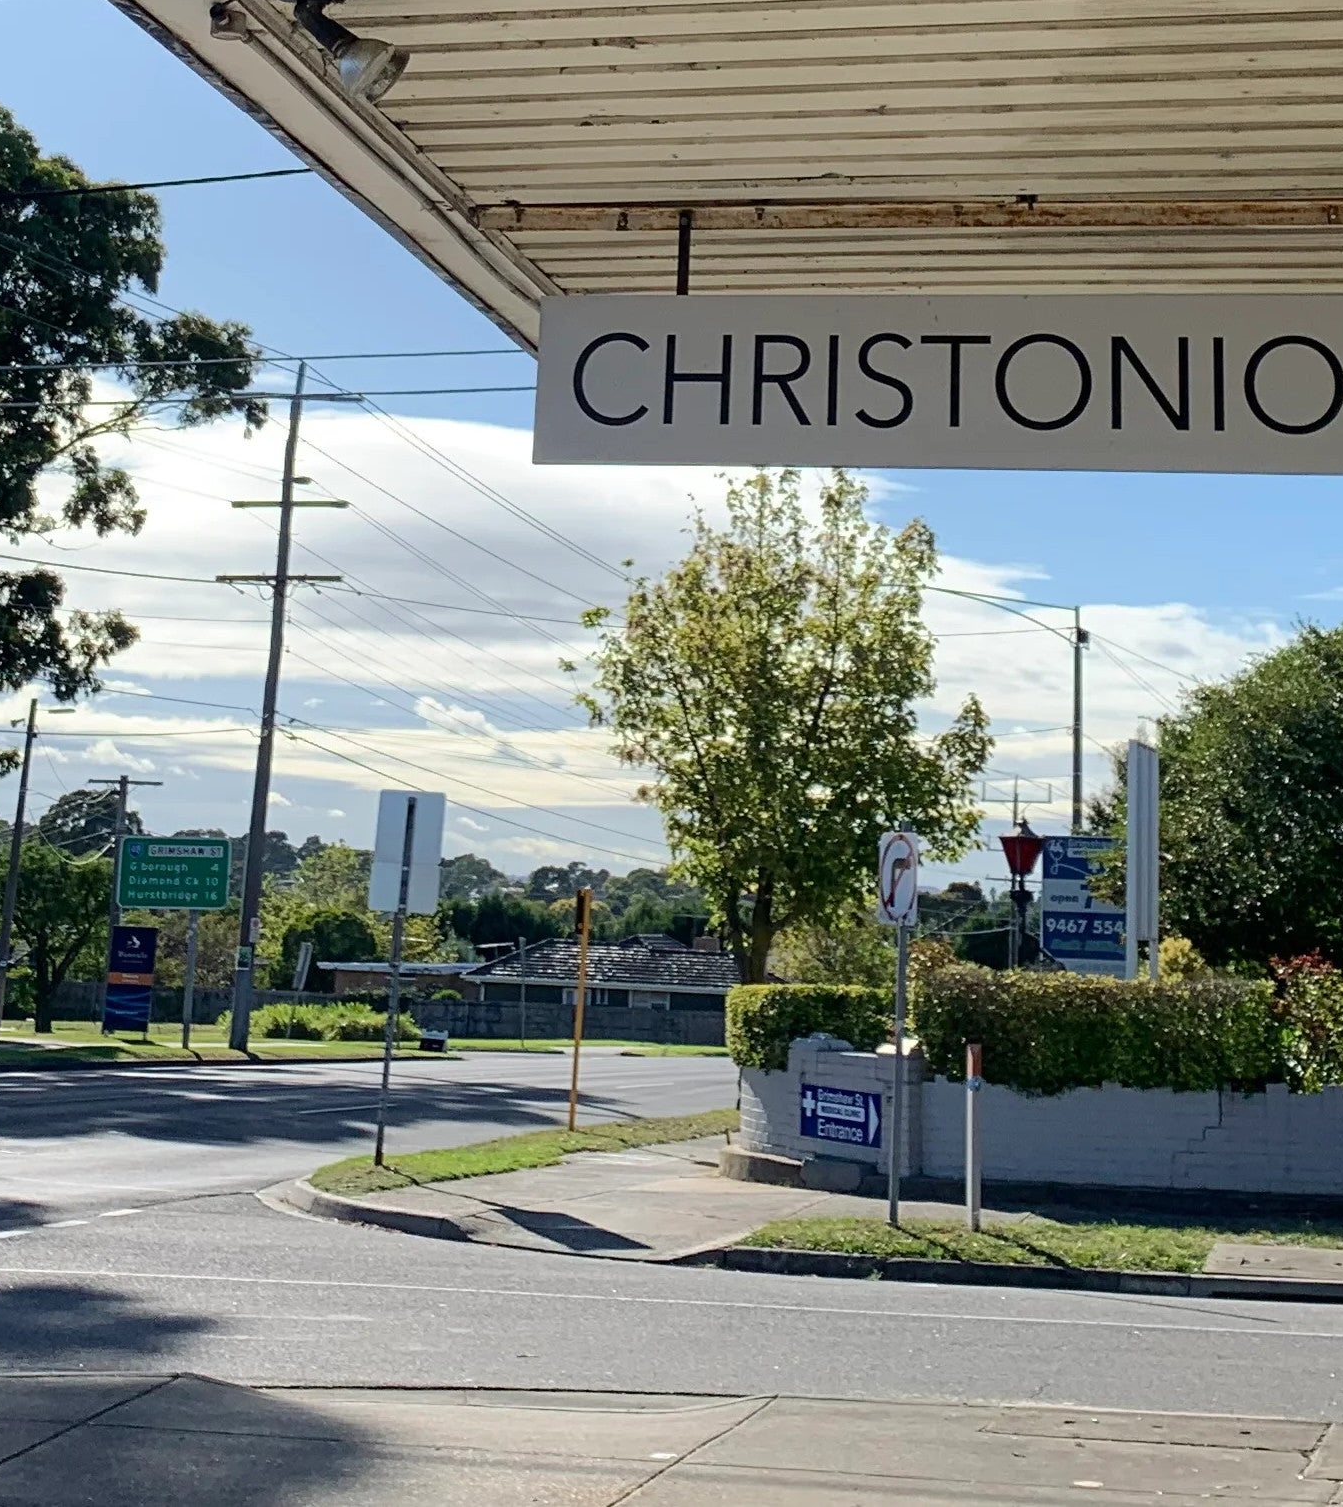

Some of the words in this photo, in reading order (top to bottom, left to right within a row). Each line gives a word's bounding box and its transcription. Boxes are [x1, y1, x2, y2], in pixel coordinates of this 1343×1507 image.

[151, 846, 205, 855] GRIMSHAW
[211, 863, 219, 871] 4
[129, 875, 180, 886] Diamond
[206, 877, 219, 886] 10
[127, 891, 199, 902] Hurstbridge
[1050, 894, 1079, 904] open
[1045, 918, 1088, 934] 9467
[1092, 920, 1125, 935] 554
[818, 1118, 863, 1142] Entrance
